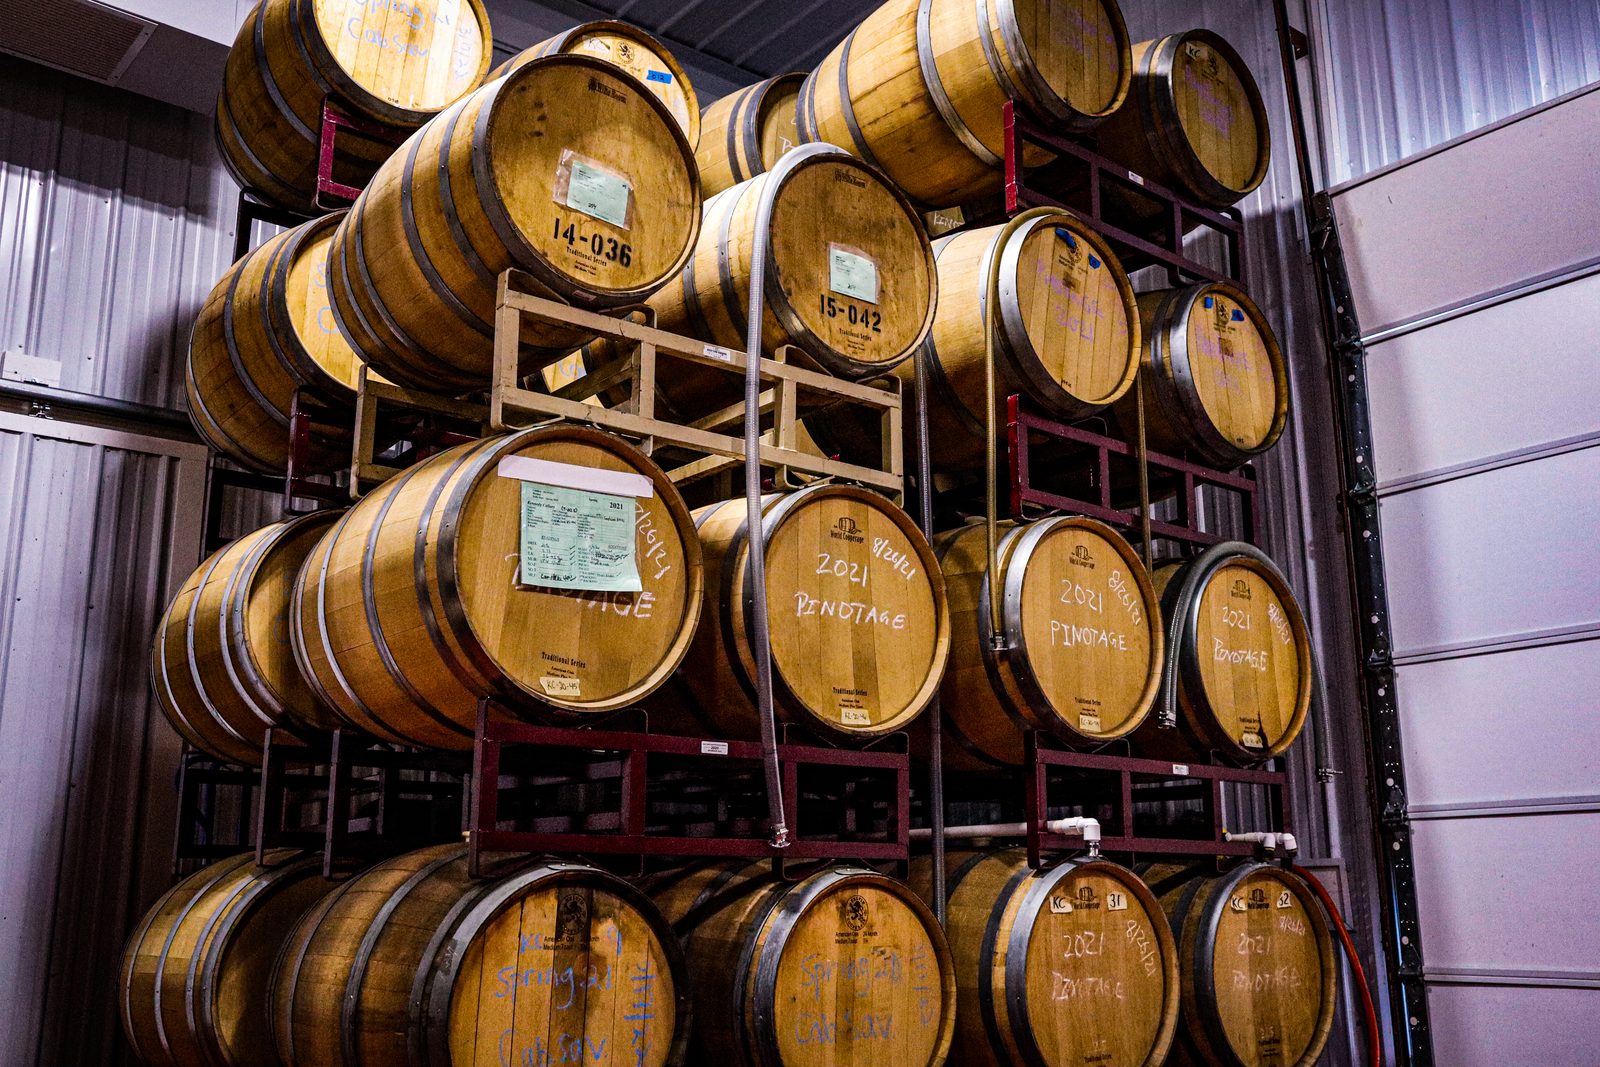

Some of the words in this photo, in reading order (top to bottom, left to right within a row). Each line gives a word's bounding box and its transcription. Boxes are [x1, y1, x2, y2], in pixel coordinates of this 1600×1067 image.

[553, 218, 632, 268] 14-036
[566, 246, 593, 261] Traditional
[593, 256, 608, 267] Series
[820, 294, 882, 333] 15-042
[839, 328, 860, 339] Traditional
[609, 502, 623, 510] 2021
[830, 530, 843, 540] World
[843, 531, 864, 544] Cooperage
[815, 553, 868, 587] 2021
[873, 537, 916, 580] 8/26/21
[1060, 579, 1103, 615] 2021
[794, 592, 905, 629] PINOTAGE
[1222, 606, 1250, 630] 2021
[1051, 620, 1128, 651] PINOTAGE
[542, 652, 569, 665] Traditional
[570, 659, 586, 668] Series
[1053, 896, 1066, 910] KC
[1110, 893, 1121, 908] 31
[1232, 897, 1244, 909] KC
[1279, 892, 1289, 907] 32
[1063, 931, 1105, 958] 2021
[1238, 933, 1271, 955] 2021
[494, 964, 576, 1010] Spring
